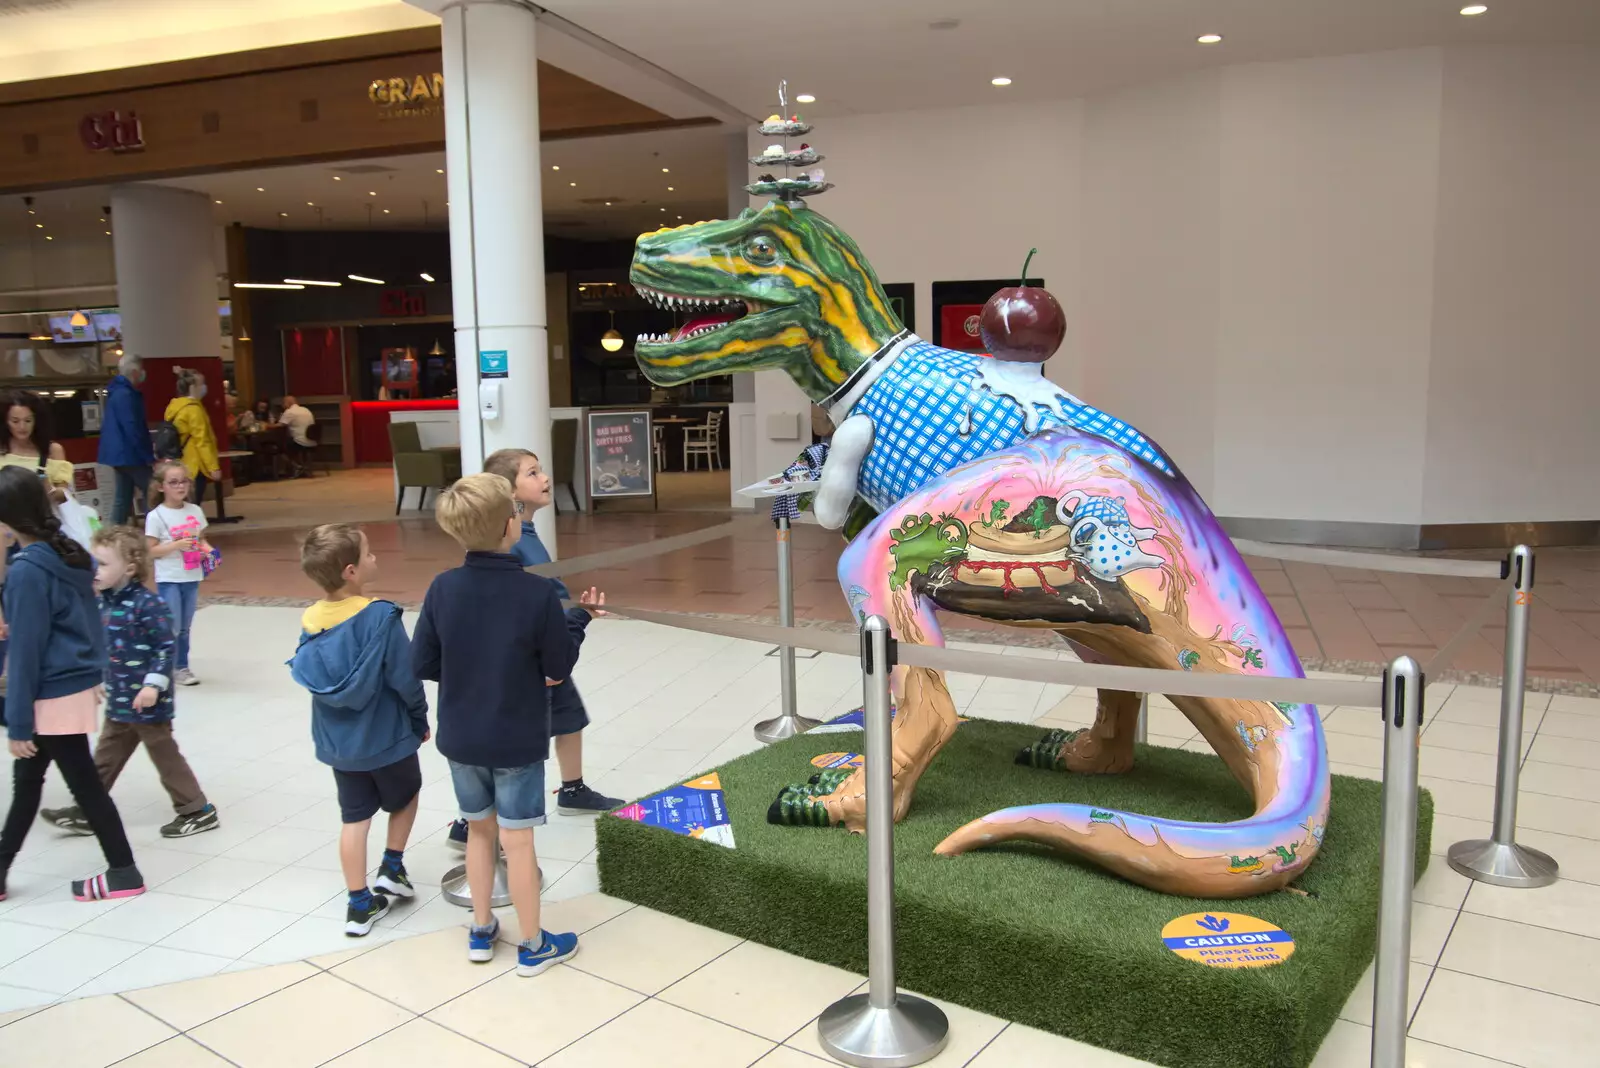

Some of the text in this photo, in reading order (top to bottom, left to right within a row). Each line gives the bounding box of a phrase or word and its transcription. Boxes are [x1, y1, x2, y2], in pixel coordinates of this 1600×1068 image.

[1184, 933, 1272, 947] CAUTION
[1199, 947, 1252, 957] Please
[1206, 953, 1280, 965] not climb
